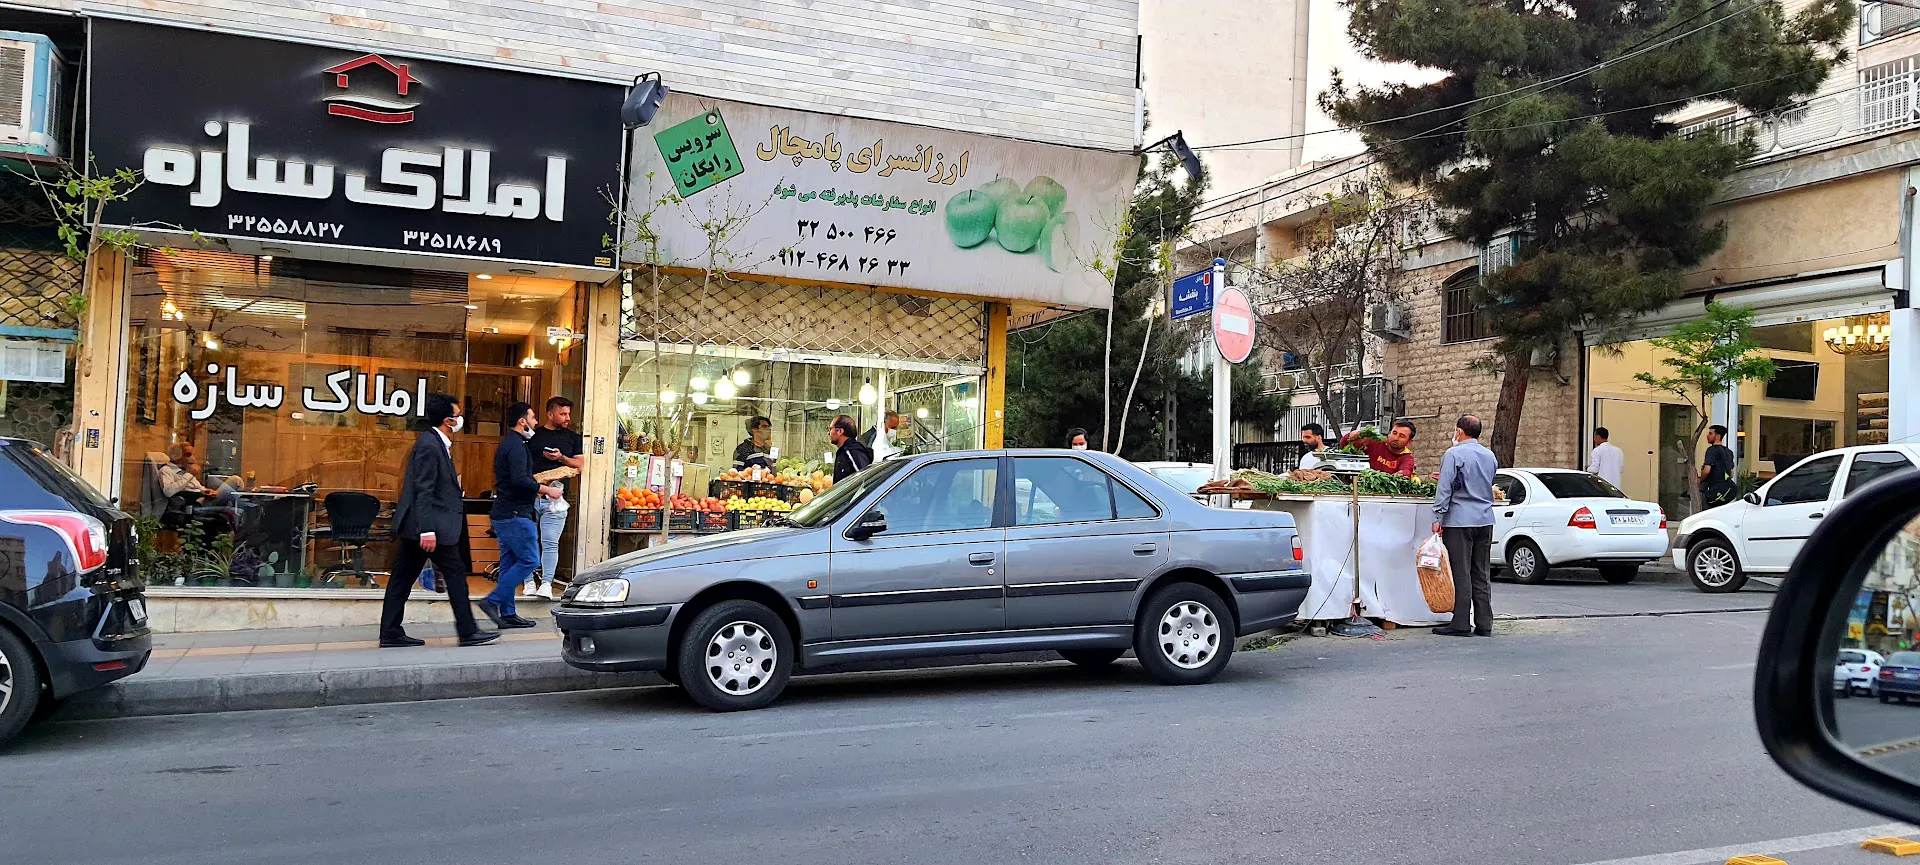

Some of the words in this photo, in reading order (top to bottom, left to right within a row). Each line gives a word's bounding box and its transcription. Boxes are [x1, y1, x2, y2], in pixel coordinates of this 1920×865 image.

[668, 128, 722, 163] سرویس
[756, 124, 843, 172] پامچال
[143, 120, 334, 208] سازه
[683, 153, 732, 188] رایگان
[345, 146, 567, 222] املاک
[774, 184, 797, 200] شود
[798, 190, 817, 203] می
[818, 187, 859, 209] پذیرفته
[861, 193, 907, 212] سفارشات
[907, 198, 937, 216] انواع
[228, 214, 344, 239] ۳۲۵۵۸۸۲۷
[797, 219, 820, 238] ۳۲
[826, 222, 854, 240] ۵۰۰
[863, 226, 897, 246] ۴۶۶
[403, 230, 501, 254] ۳۲۵۱۸۶۸۹
[172, 362, 284, 421] سازه
[302, 369, 428, 418] املاک
